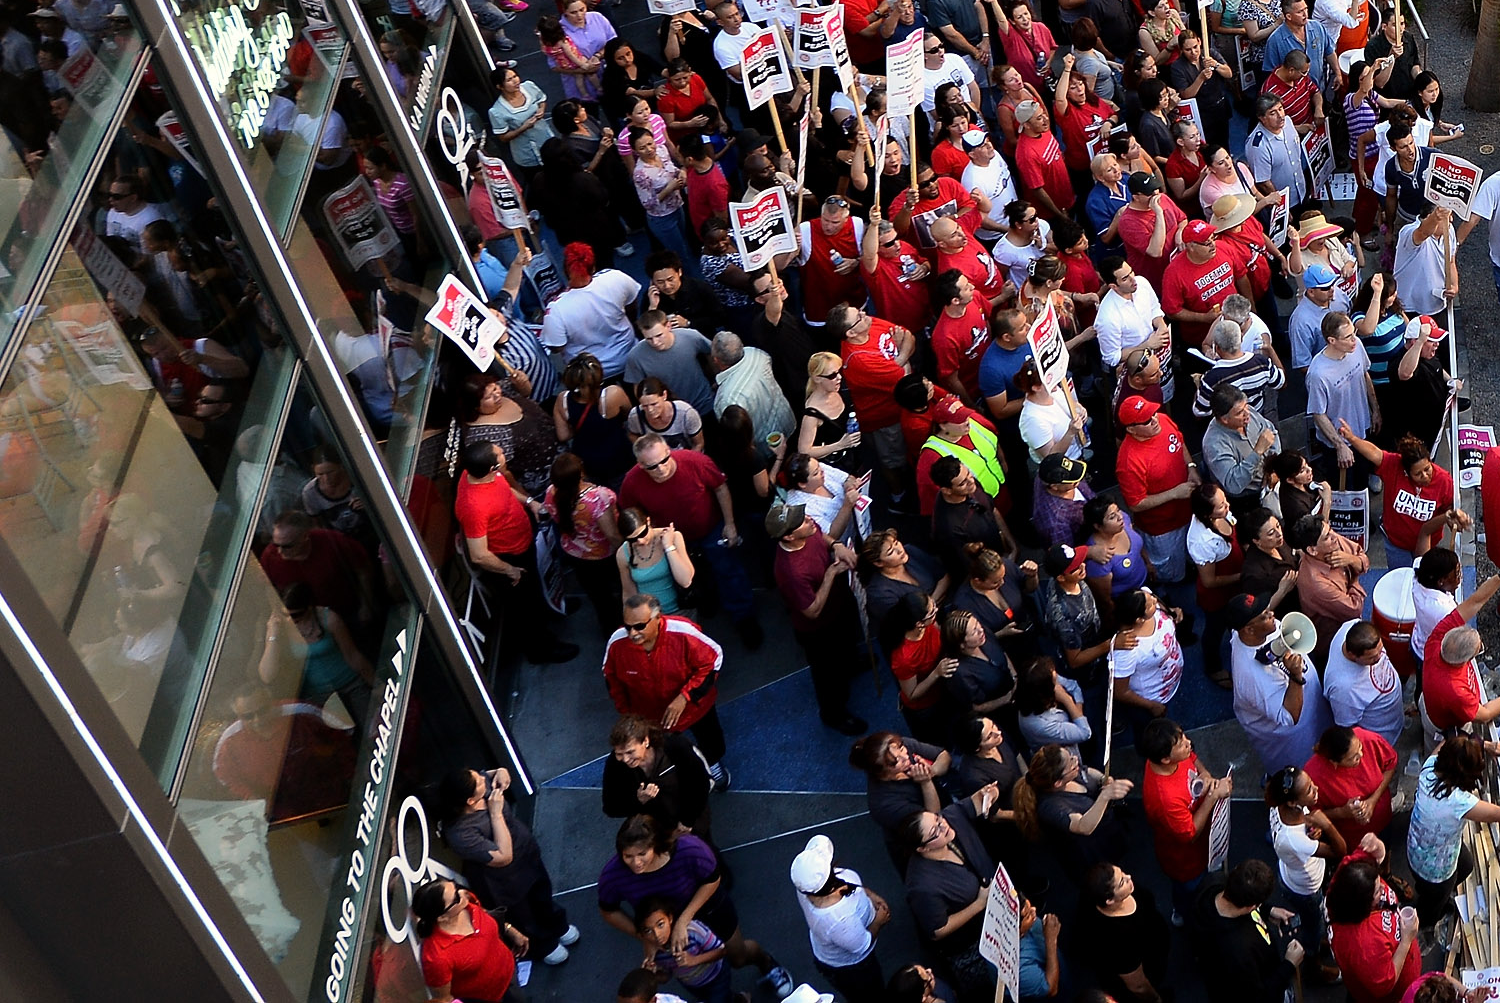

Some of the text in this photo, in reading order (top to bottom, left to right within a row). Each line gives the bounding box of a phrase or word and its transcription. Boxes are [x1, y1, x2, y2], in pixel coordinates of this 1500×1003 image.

[1435, 166, 1473, 185] JUSTICE
[1448, 165, 1461, 174] NO
[1436, 184, 1465, 198] PEACE
[1444, 182, 1459, 190] NO
[1465, 431, 1477, 439] NO
[1399, 491, 1435, 512] UNITE
[1395, 502, 1433, 521] HERE!
[326, 678, 401, 1003] GOING TO THE CHAPEL
